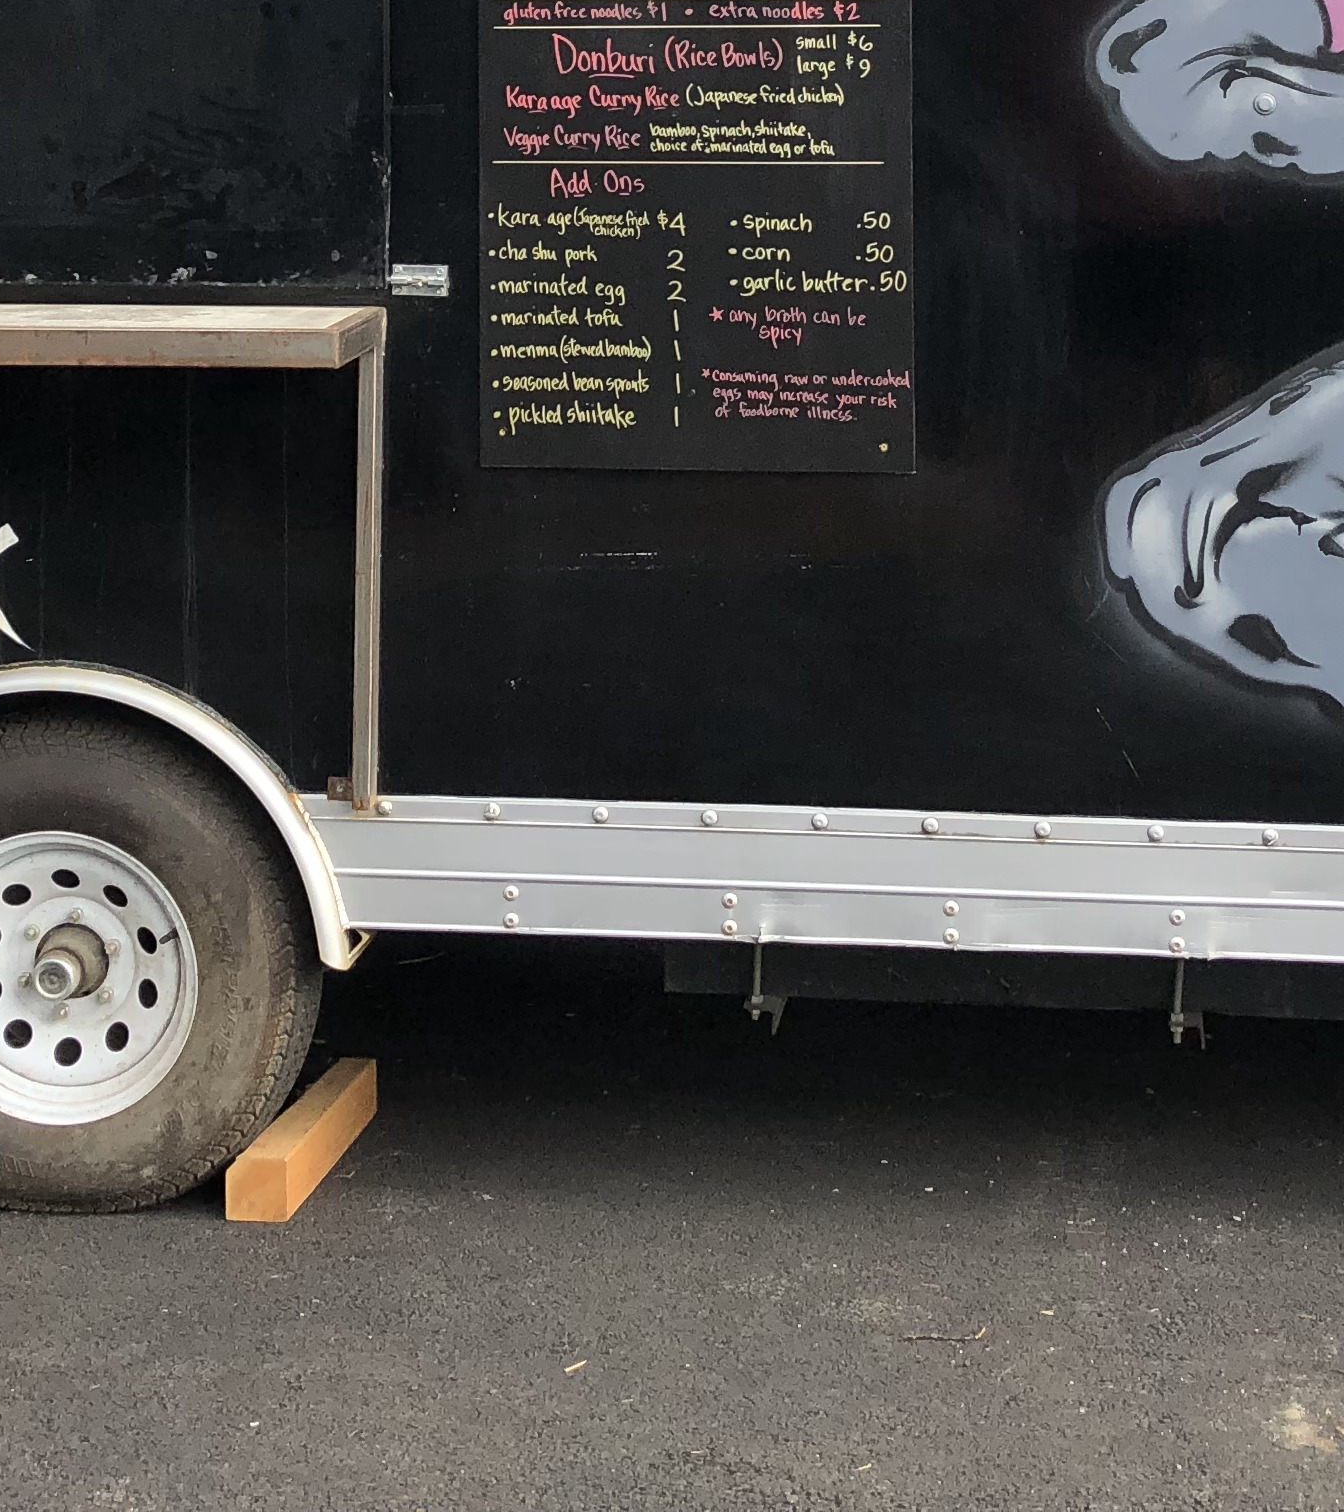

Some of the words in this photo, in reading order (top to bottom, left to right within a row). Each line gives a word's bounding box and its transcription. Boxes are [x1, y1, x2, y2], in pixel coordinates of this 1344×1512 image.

[504, 2, 551, 25] gluten
[554, 1, 587, 18] free
[591, 2, 641, 20] noodles
[647, 1, 666, 21] $1
[709, 1, 758, 19] extra
[763, 1, 824, 20] noodles
[834, 1, 860, 21] $2
[796, 34, 836, 50] small
[848, 30, 873, 51] $6
[552, 33, 655, 74] Donburi
[665, 36, 717, 71] (Rice
[721, 38, 783, 70] Bowls)
[797, 55, 836, 79] large
[589, 85, 641, 115] Curry
[645, 85, 680, 107] Rice
[686, 83, 757, 110] (Japanese
[798, 83, 844, 106] chicken)
[503, 125, 550, 155] Veggie
[554, 124, 600, 153] Curry
[605, 124, 640, 147] Rice
[650, 140, 687, 152] choice
[770, 142, 791, 158] egg
[794, 144, 806, 155] or
[809, 139, 835, 156] tofu
[551, 168, 592, 198] Add
[604, 170, 645, 193] Ons
[498, 203, 541, 228] kara
[657, 210, 686, 236] $4
[743, 212, 812, 238] spinach
[856, 211, 891, 229] .50
[594, 226, 640, 239] chicken)
[499, 239, 527, 261] cha
[532, 240, 557, 261] shu
[565, 245, 597, 267] pork
[667, 250, 685, 272] 2
[742, 247, 790, 262] corn
[856, 242, 894, 263] .50
[498, 273, 588, 297] marinated
[595, 283, 625, 305] egg
[667, 281, 686, 302] 2
[740, 269, 796, 296] garlic
[802, 270, 868, 293] butter
[870, 270, 907, 292] .50
[501, 305, 579, 326] marinated
[584, 307, 623, 327] tofu
[729, 310, 757, 329] any
[765, 306, 806, 324] broth
[813, 311, 840, 325] can
[848, 306, 866, 326] be
[500, 345, 557, 359] menma
[605, 336, 651, 362] bamboo)
[759, 325, 801, 349] spicy
[503, 371, 568, 391] seasoned
[572, 371, 604, 391] bean
[606, 369, 649, 399] sprouts
[784, 374, 809, 386] raw
[813, 374, 827, 385] or
[832, 369, 910, 388] undercooked
[713, 388, 741, 405] eggs
[747, 391, 773, 406] may
[779, 390, 828, 404] increase
[836, 393, 866, 410] your
[870, 392, 896, 408] risk
[715, 402, 730, 417] of
[739, 402, 799, 417] foodborne
[509, 402, 561, 435] pickled
[567, 400, 636, 429] shiitake
